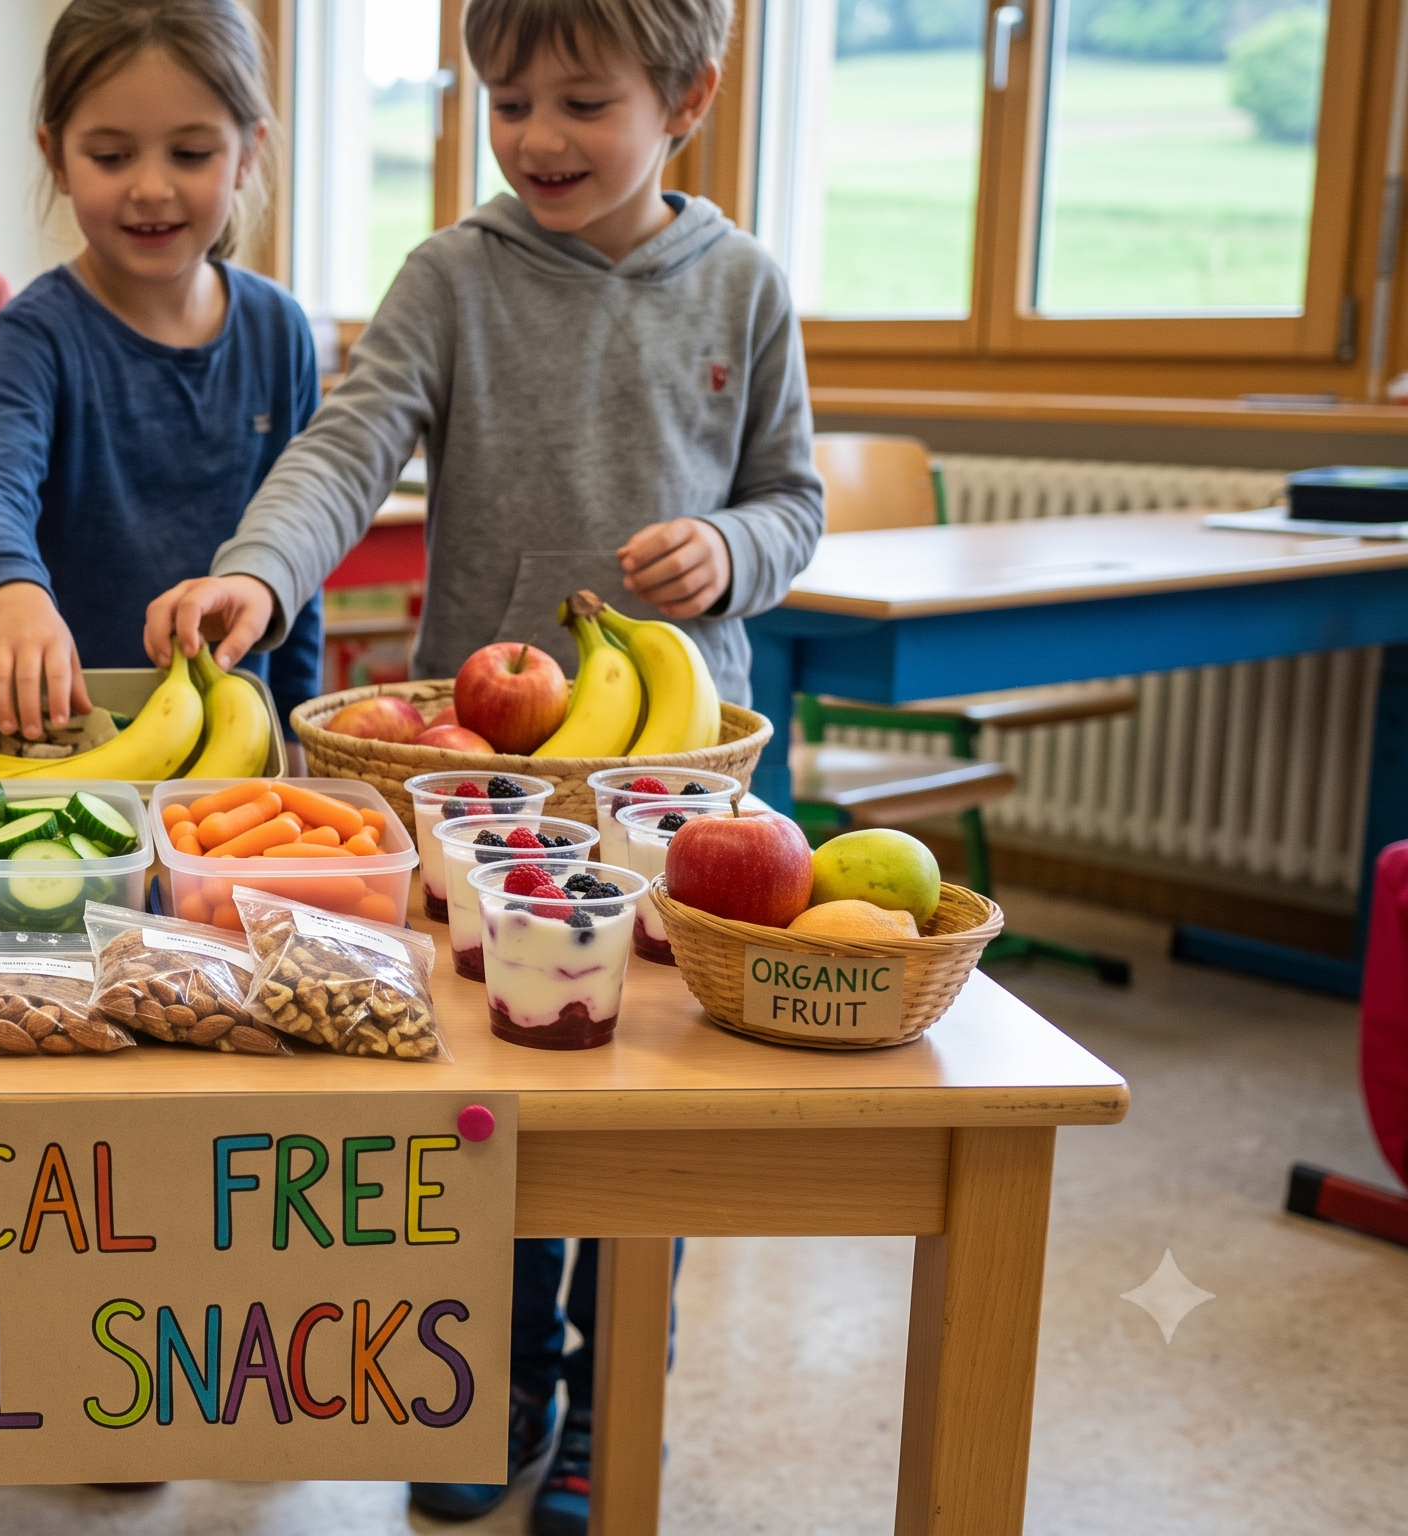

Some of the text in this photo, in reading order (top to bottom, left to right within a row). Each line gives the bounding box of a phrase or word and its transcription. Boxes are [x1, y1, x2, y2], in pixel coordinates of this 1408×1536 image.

[751, 957, 891, 993] ORGANIC
[772, 994, 867, 1028] FRUIT
[213, 1133, 461, 1251] FREE
[83, 1298, 475, 1430] SNACKS
